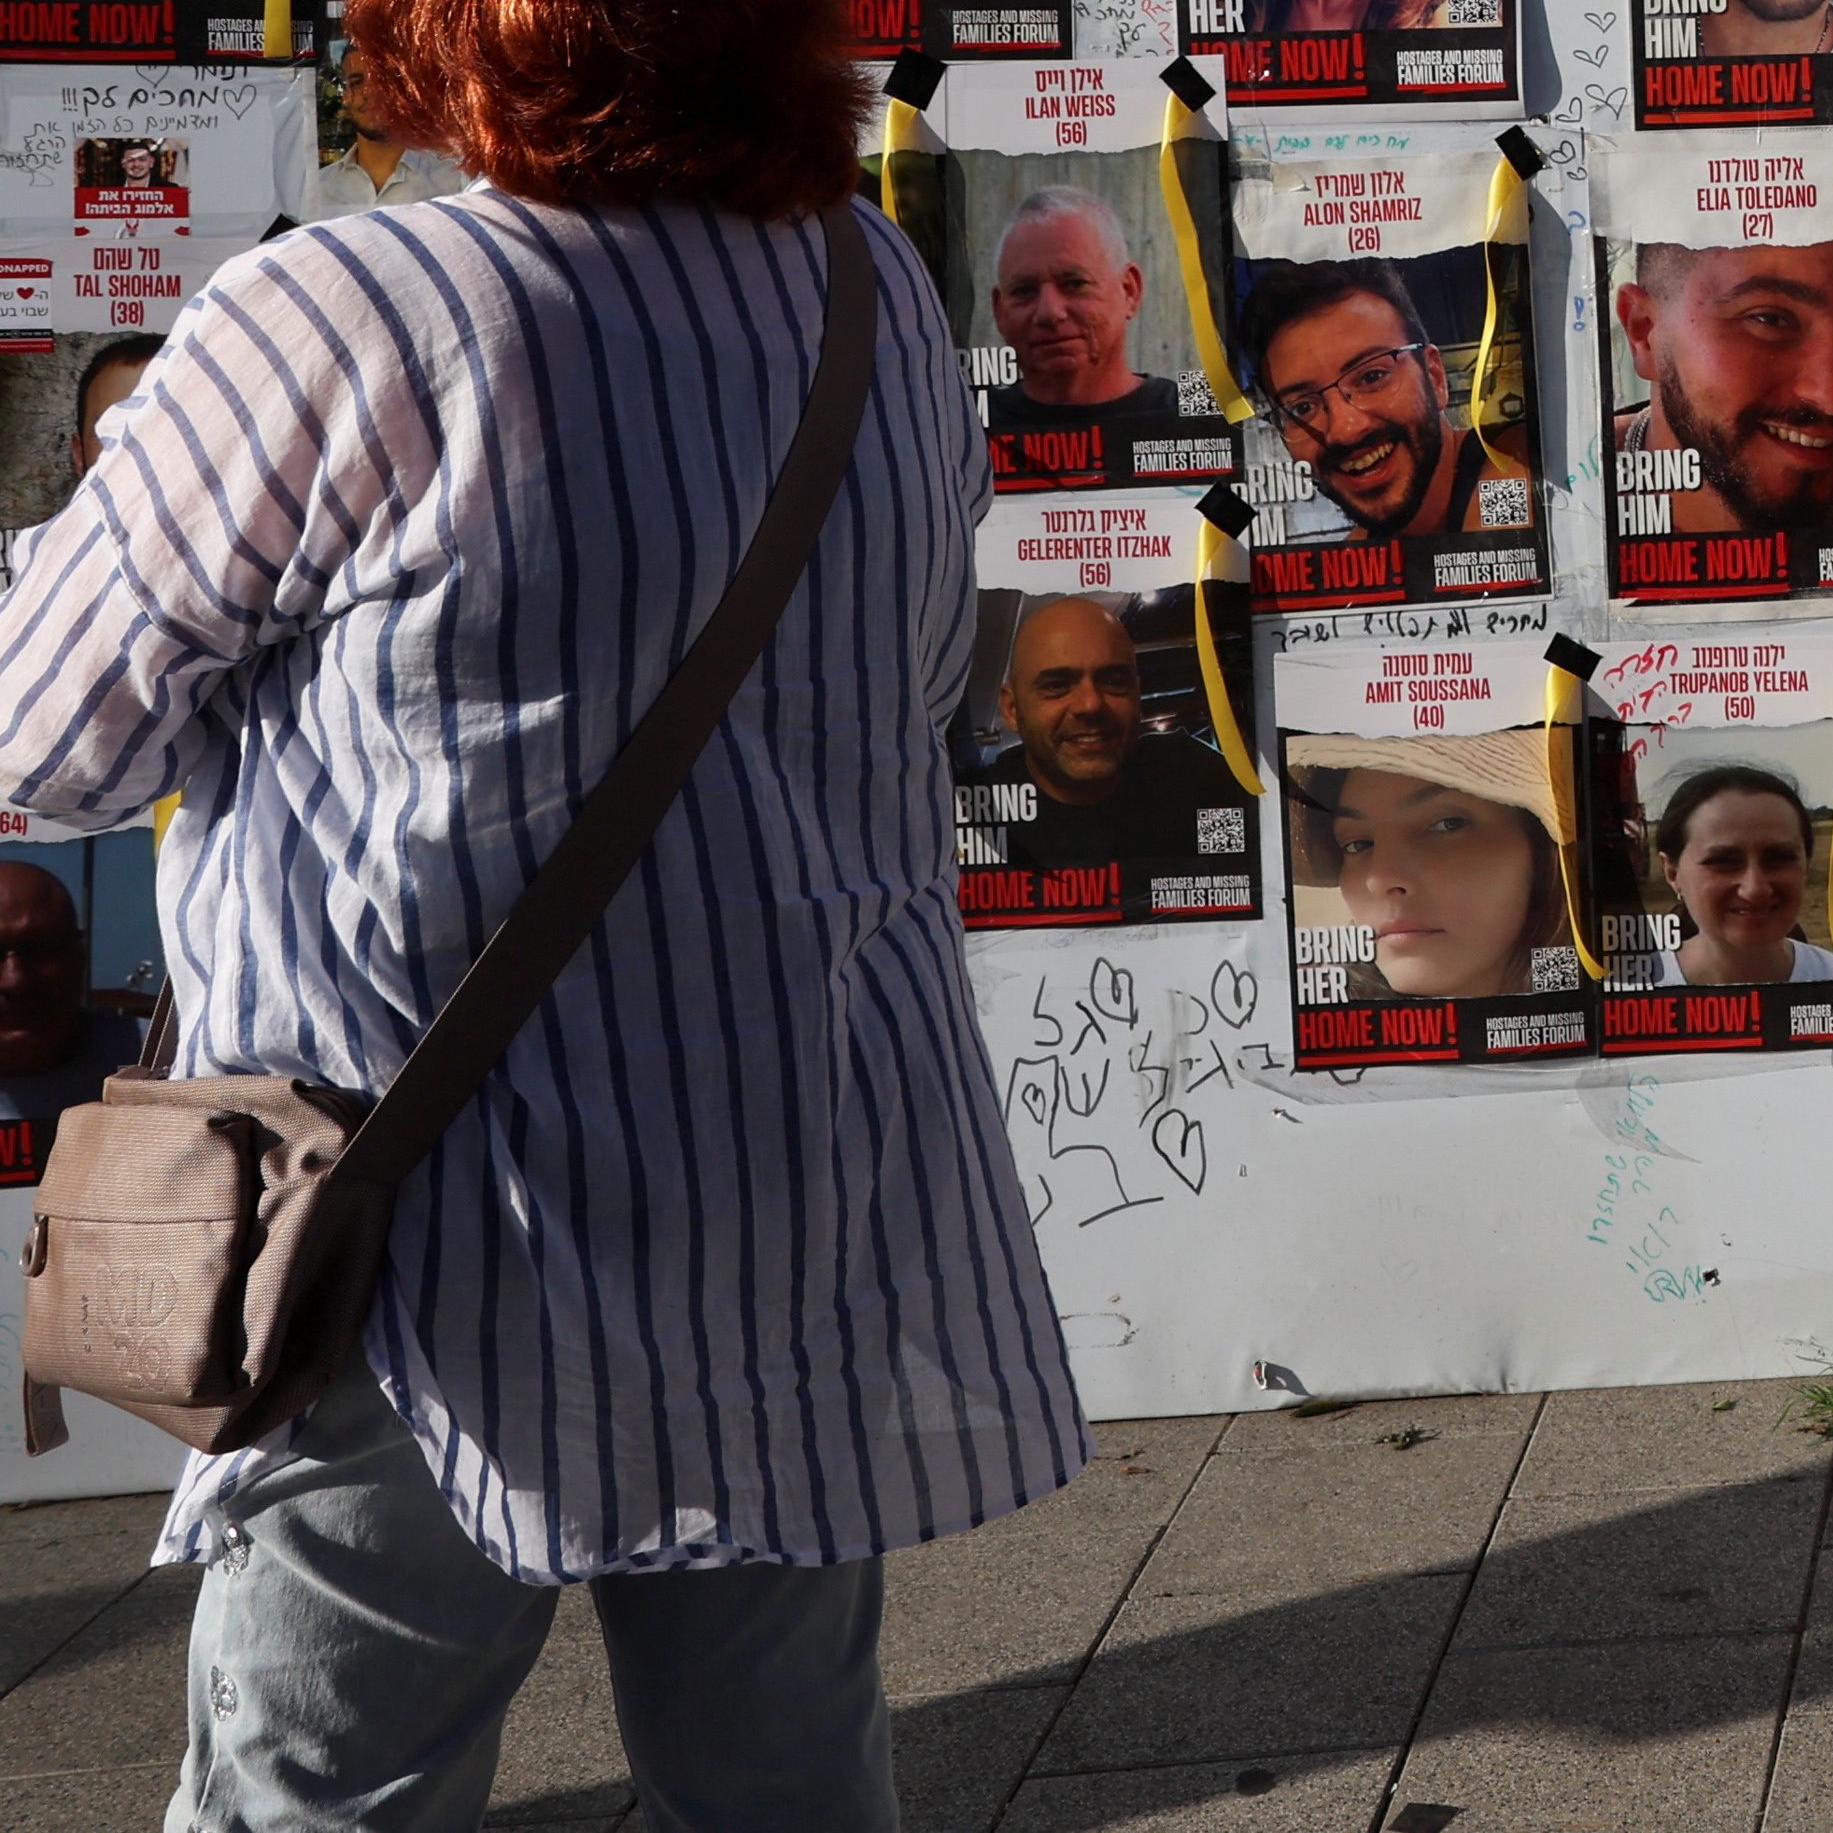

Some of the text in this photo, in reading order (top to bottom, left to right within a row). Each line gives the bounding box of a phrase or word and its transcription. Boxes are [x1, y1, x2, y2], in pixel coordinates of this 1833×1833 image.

[1027, 95, 1114, 118] ILAN WEISS
[1698, 186, 1816, 210] ELIA TOLEDANO
[1305, 199, 1421, 224] ALON SHAMRIZ
[75, 275, 180, 296] TAL SHOHAM
[1019, 537, 1170, 560] GELERENTER ITZHAK
[1367, 679, 1490, 702] AMIT SOUSSANA
[1671, 672, 1807, 693] TRUPANOB YELENA
